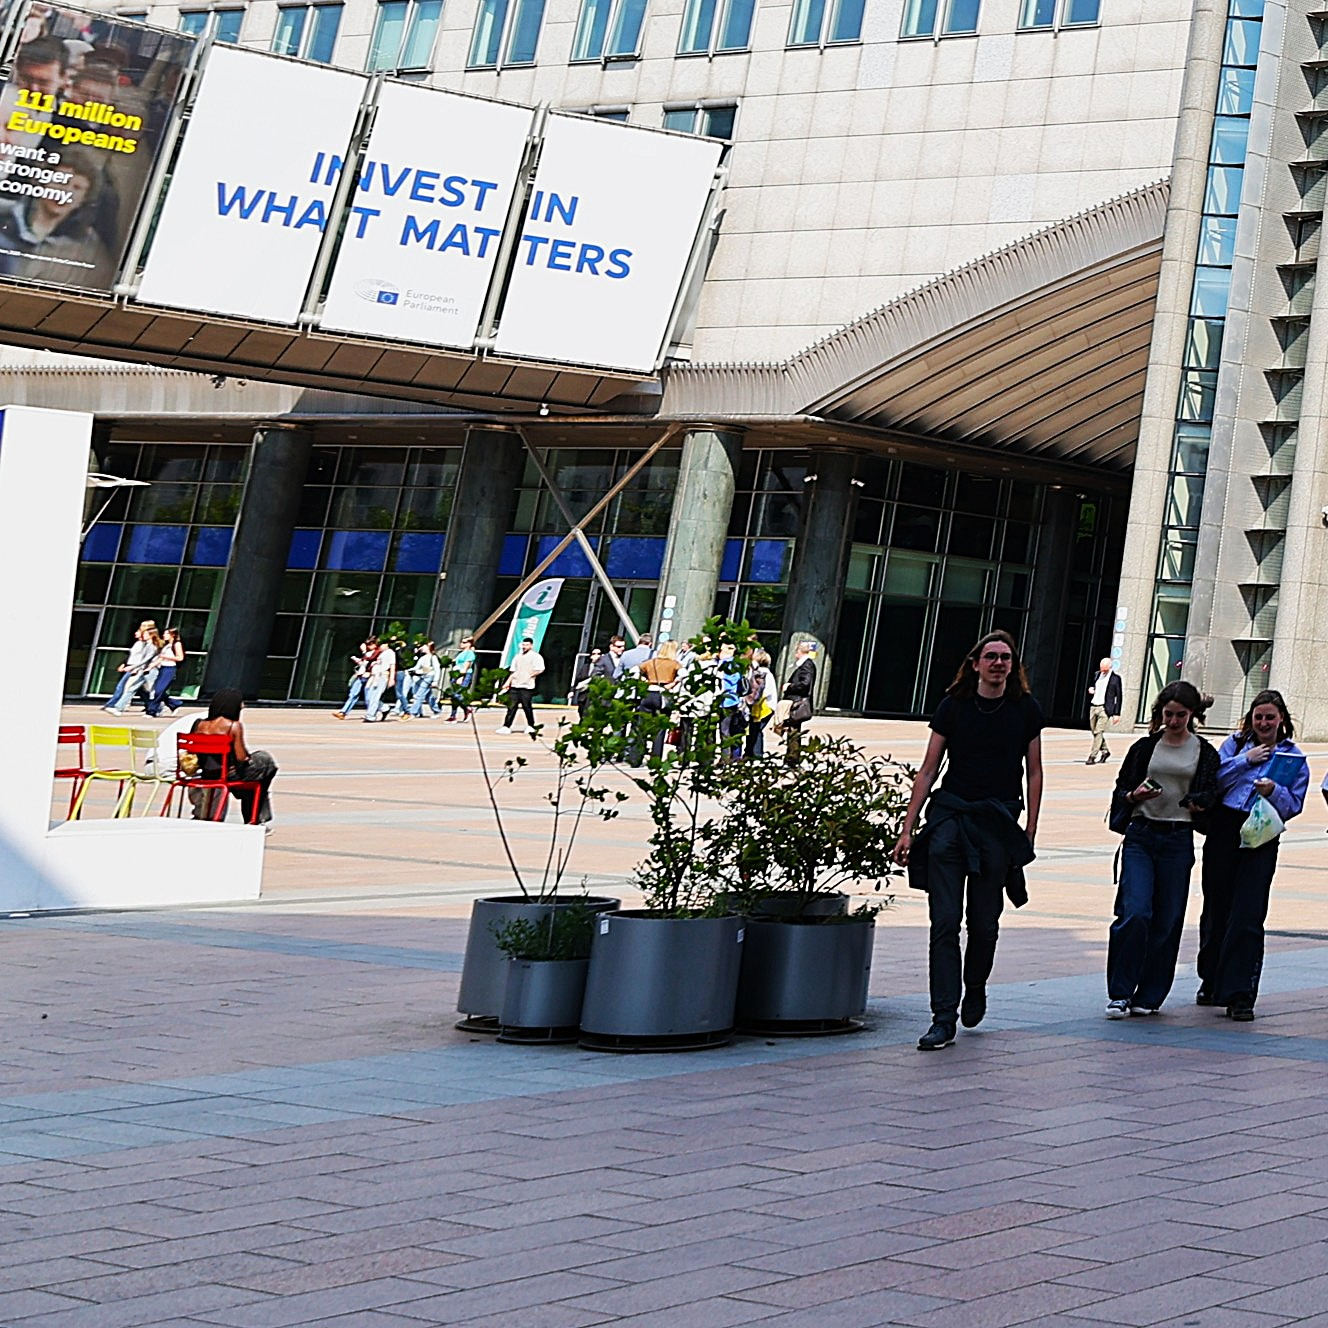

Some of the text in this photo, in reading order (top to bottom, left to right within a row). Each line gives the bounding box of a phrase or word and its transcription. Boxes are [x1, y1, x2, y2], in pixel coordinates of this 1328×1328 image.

[14, 88, 142, 132] 111 million
[7, 111, 138, 154] Europeans
[0, 142, 61, 165] want a
[0, 178, 73, 205] conomy.
[309, 151, 579, 226] INVEST IN
[217, 181, 633, 280] WHAT MATTERS
[402, 299, 459, 316] Parliament
[405, 289, 455, 305] European
